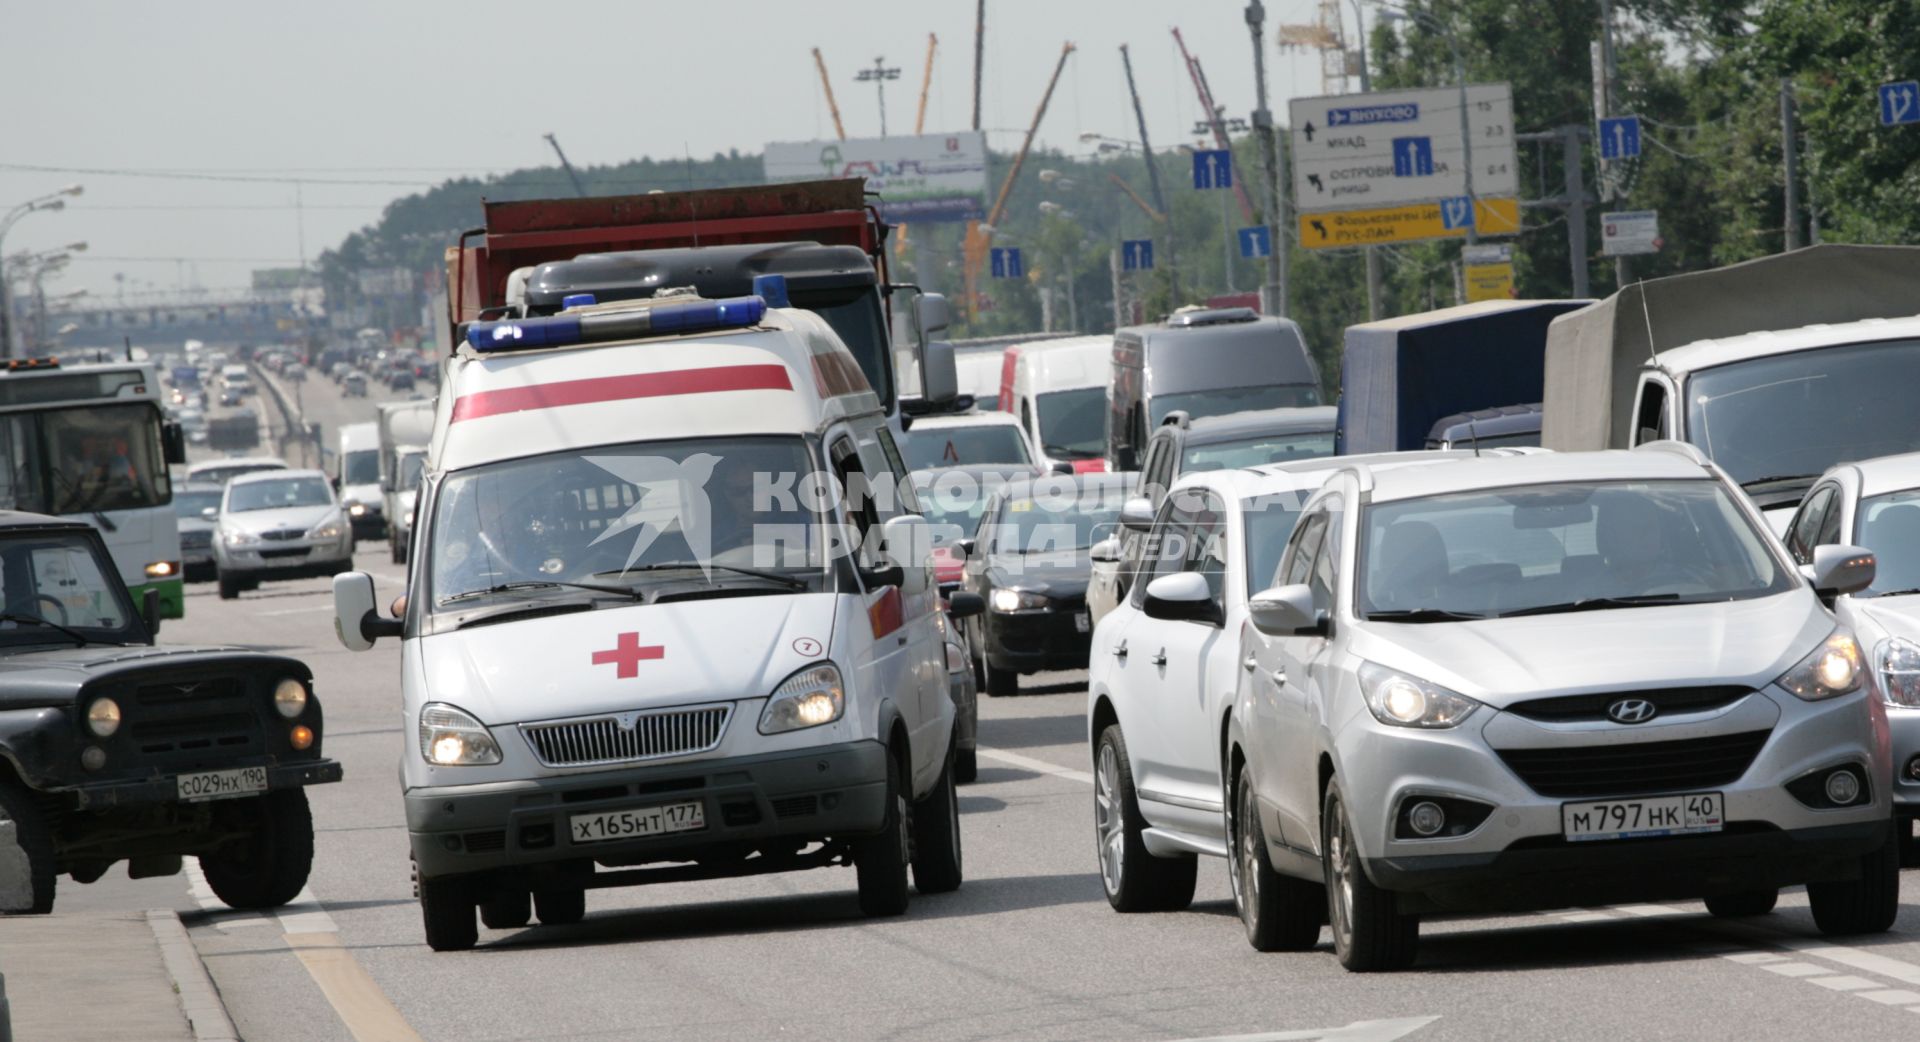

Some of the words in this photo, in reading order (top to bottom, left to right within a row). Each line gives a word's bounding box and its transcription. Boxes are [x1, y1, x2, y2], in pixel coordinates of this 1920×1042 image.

[1349, 105, 1415, 122] ВНУКОВО
[1327, 136, 1366, 148] МКАД
[803, 642, 812, 650] 7
[578, 813, 661, 838] Х165НТ
